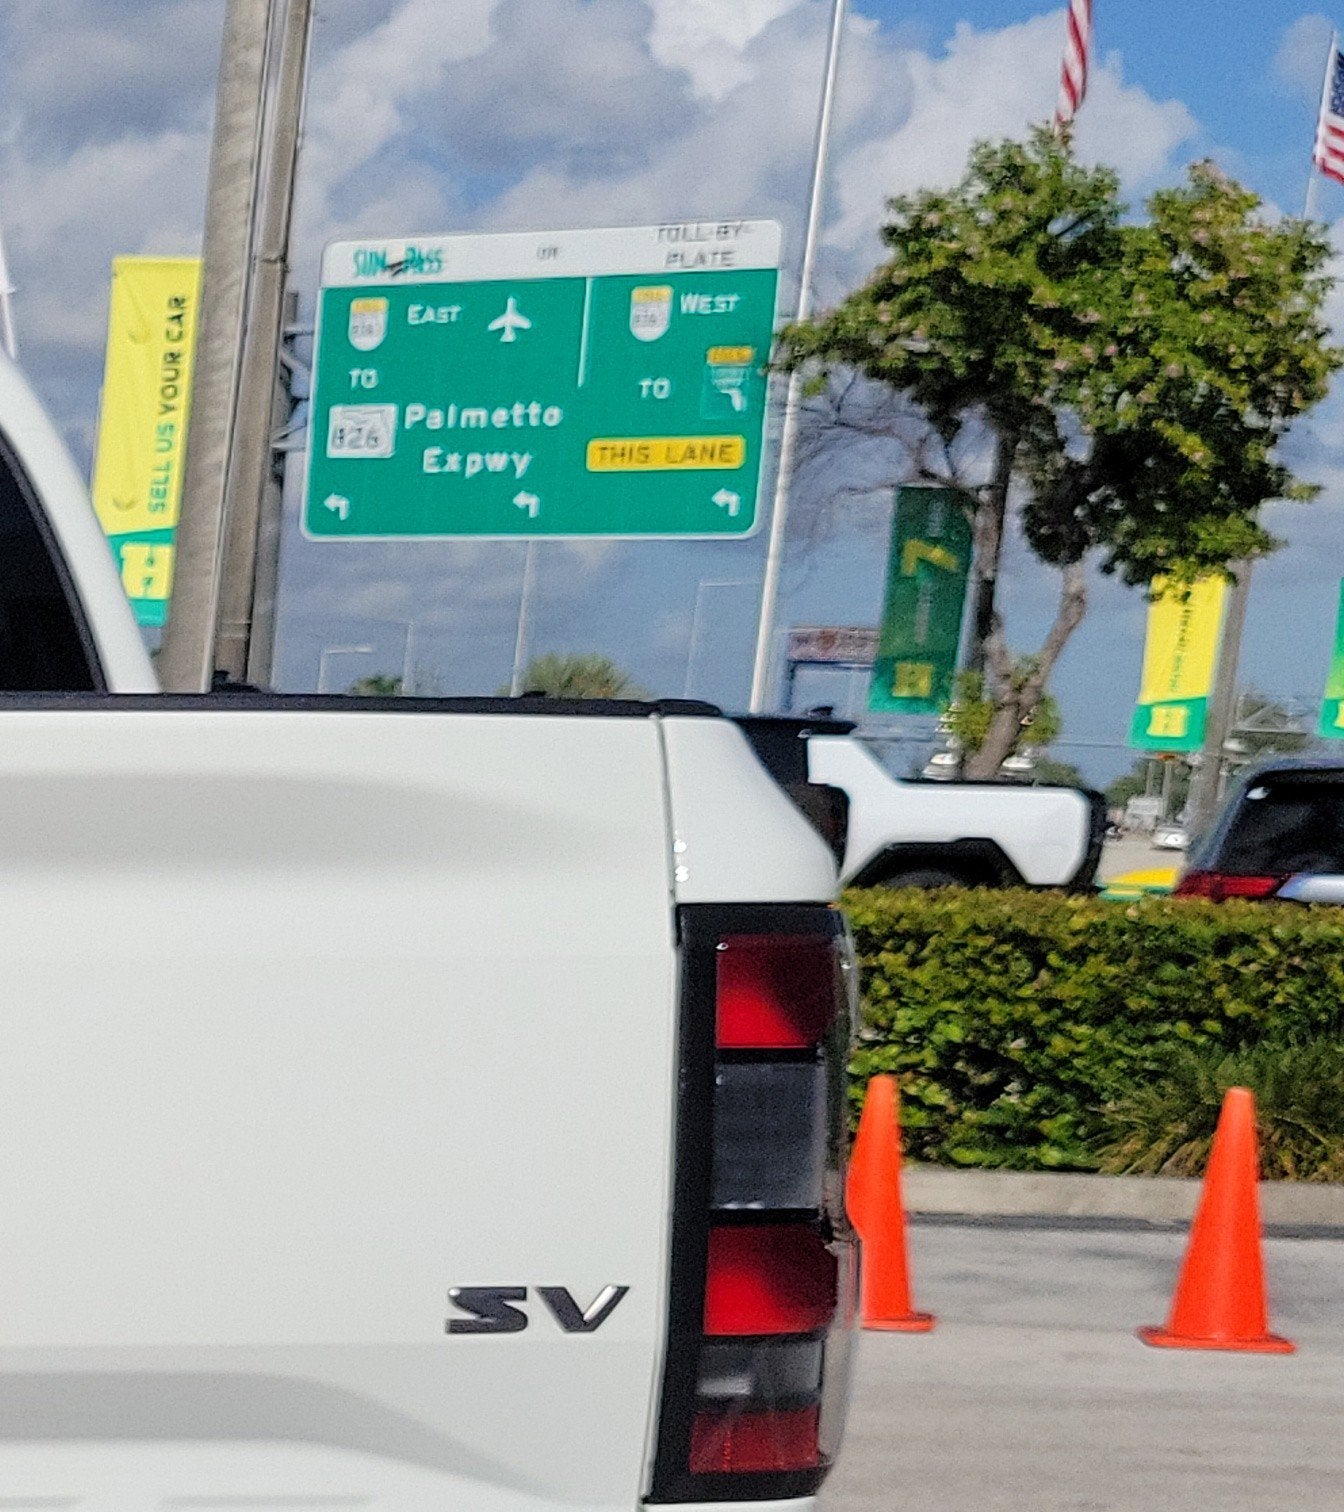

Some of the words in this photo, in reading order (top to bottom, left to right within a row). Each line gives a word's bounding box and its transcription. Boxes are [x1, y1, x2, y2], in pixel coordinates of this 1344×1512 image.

[407, 303, 462, 325] EAST
[680, 292, 741, 315] WEST
[165, 295, 187, 344] CAR
[160, 350, 183, 415] YOUR
[348, 367, 379, 389] TO
[639, 377, 671, 399] TO
[404, 400, 563, 430] Palmetto
[155, 422, 177, 454] US
[423, 445, 533, 480] Expwy
[598, 444, 650, 465] THIS
[665, 443, 734, 465] LANE
[148, 461, 172, 513] SELL
[445, 1286, 631, 1334] SV
